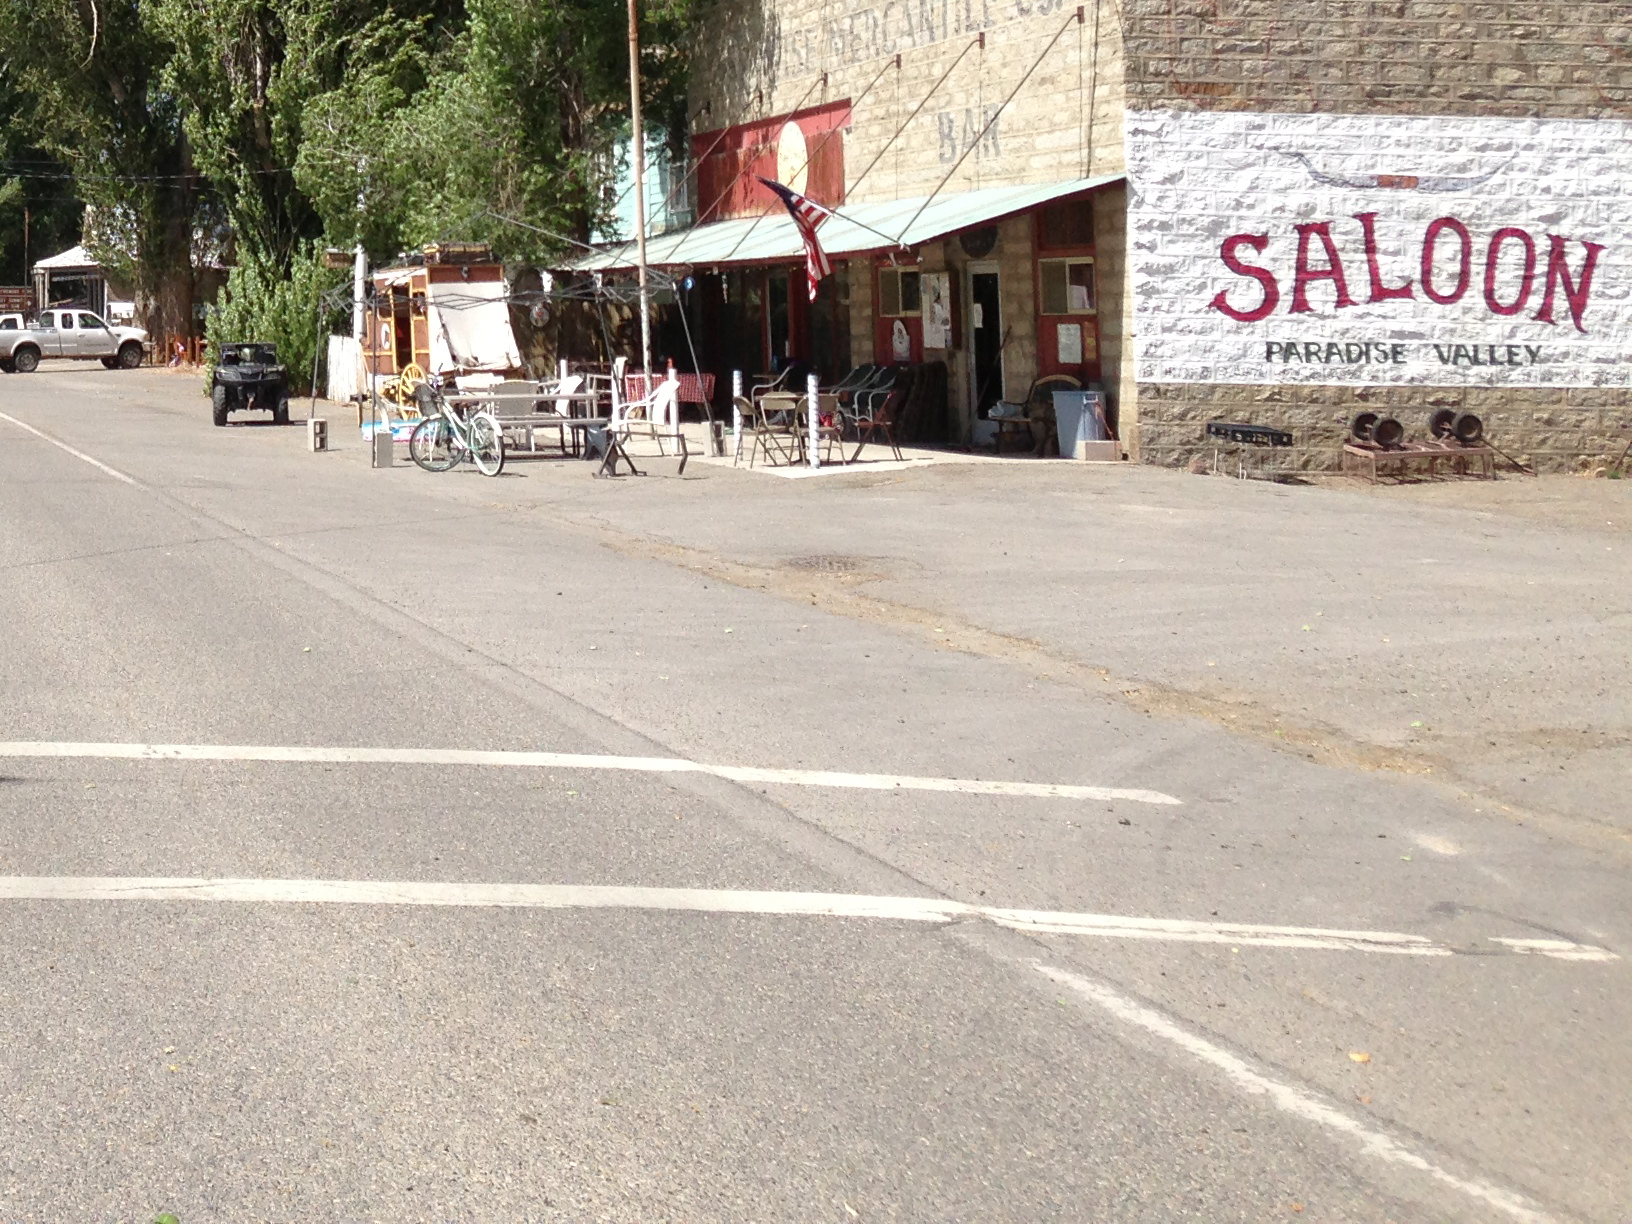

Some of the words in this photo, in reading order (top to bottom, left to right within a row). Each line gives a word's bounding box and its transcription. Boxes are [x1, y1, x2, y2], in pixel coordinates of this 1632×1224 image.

[938, 103, 1001, 164] BAR
[1208, 212, 1608, 333] SALOON
[1267, 341, 1406, 365] PARADISE
[1433, 343, 1542, 365] VALLEY
